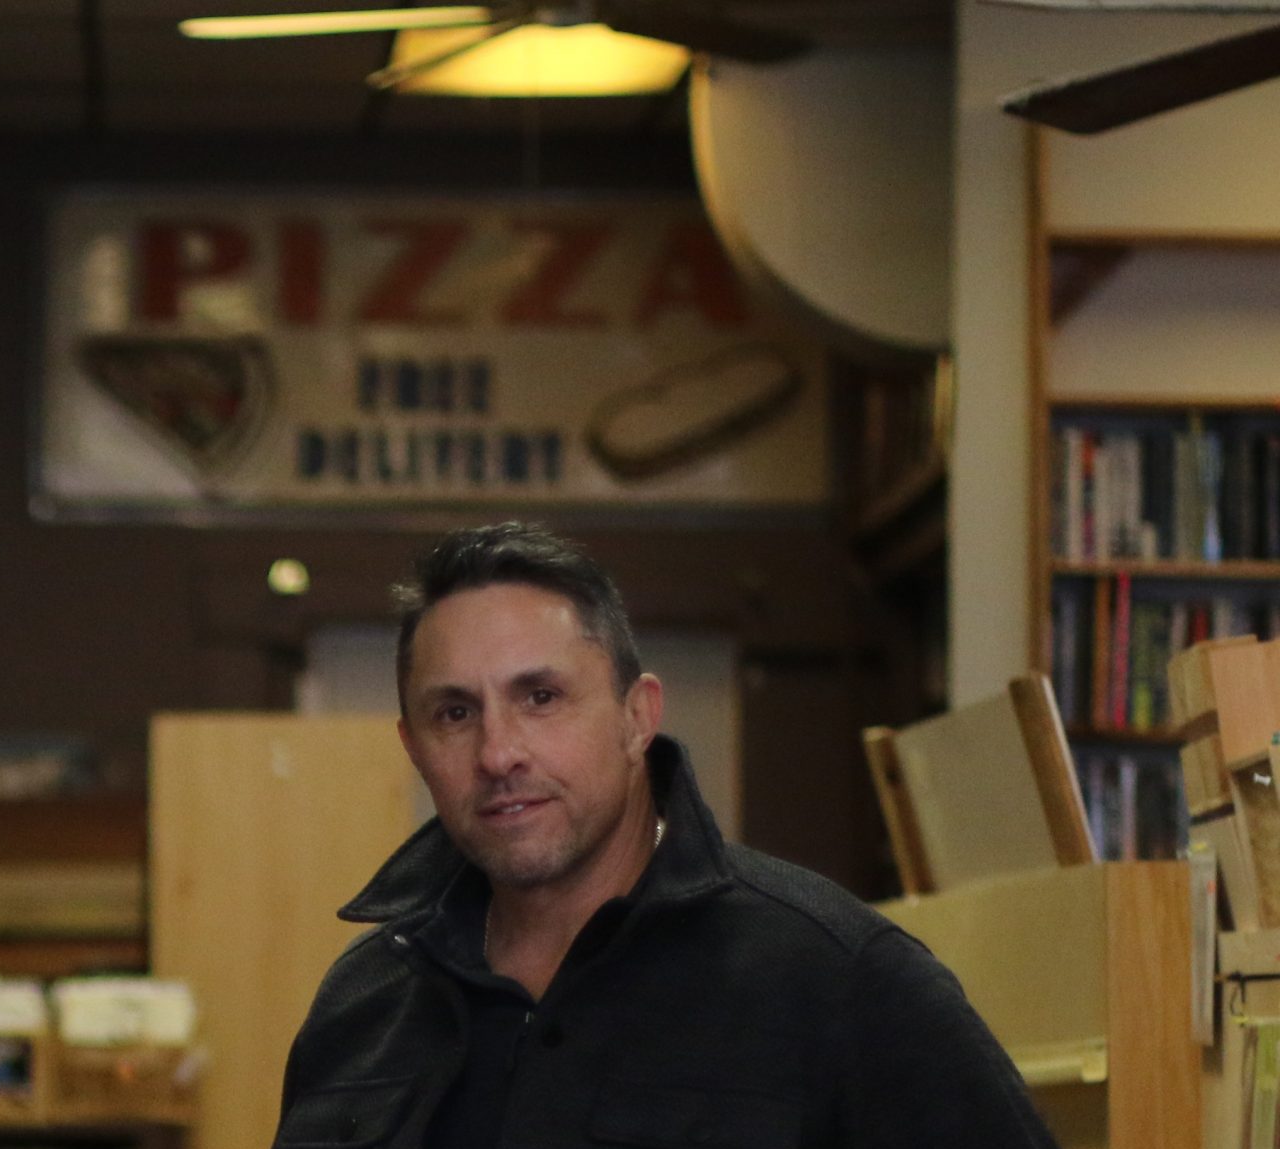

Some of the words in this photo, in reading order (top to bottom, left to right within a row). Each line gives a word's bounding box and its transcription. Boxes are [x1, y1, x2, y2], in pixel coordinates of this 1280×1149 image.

[136, 219, 754, 326] PIZZA
[357, 357, 491, 412] FREE
[297, 426, 563, 483] DELIVERY
